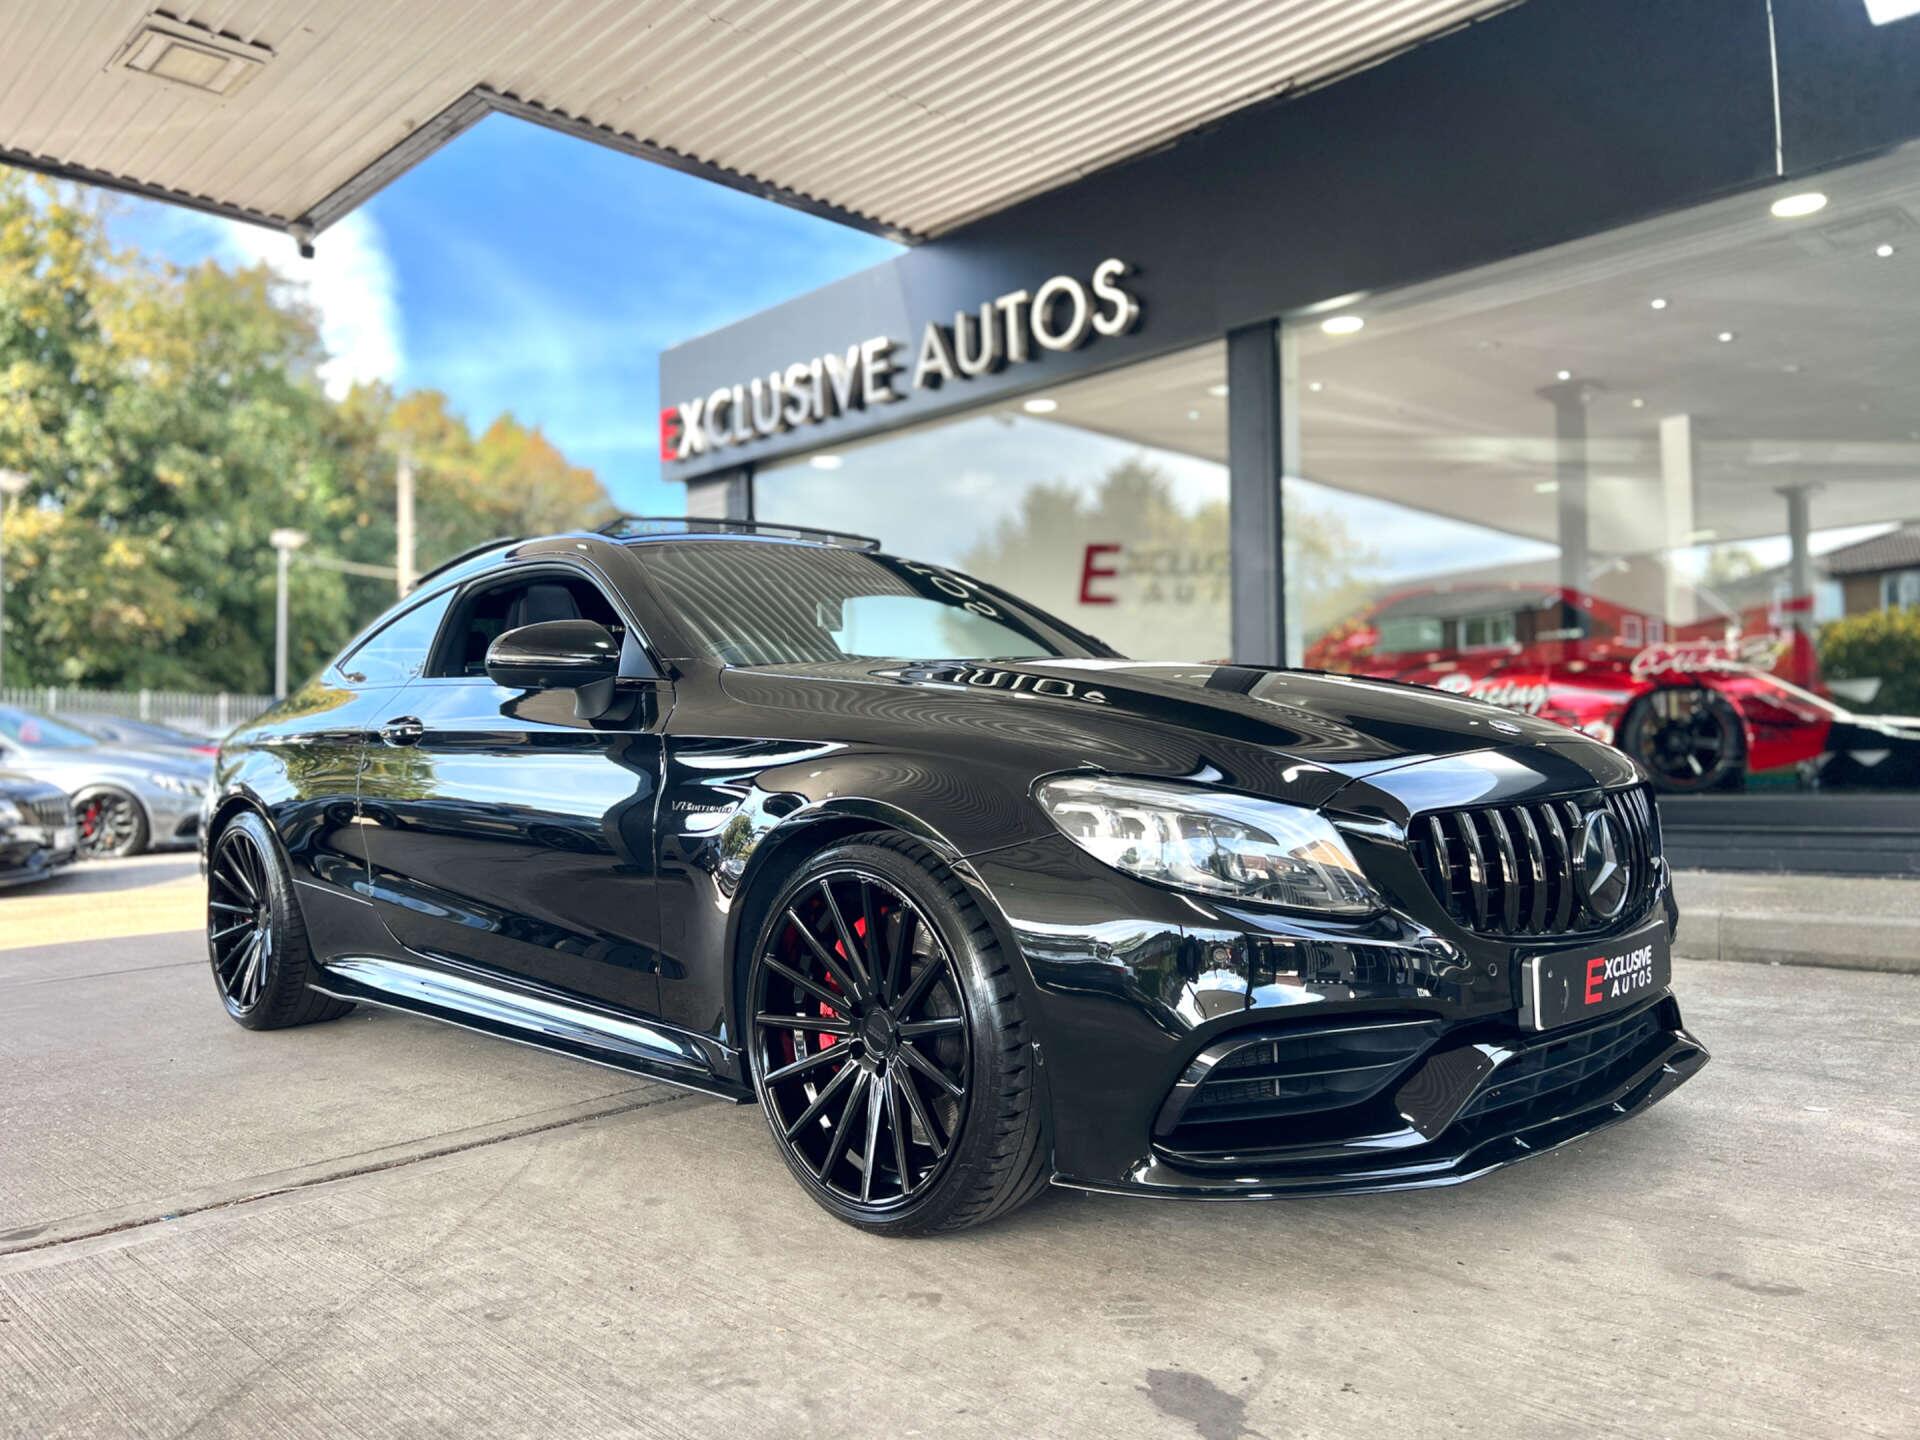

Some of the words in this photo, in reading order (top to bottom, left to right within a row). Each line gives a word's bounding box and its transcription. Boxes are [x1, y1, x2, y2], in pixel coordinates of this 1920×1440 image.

[660, 335, 898, 462] EXCLUSIVE
[912, 257, 1140, 390] AUTOS
[1584, 945, 1653, 1005] EXCLUSIVE
[1611, 966, 1653, 998] AUTOS
